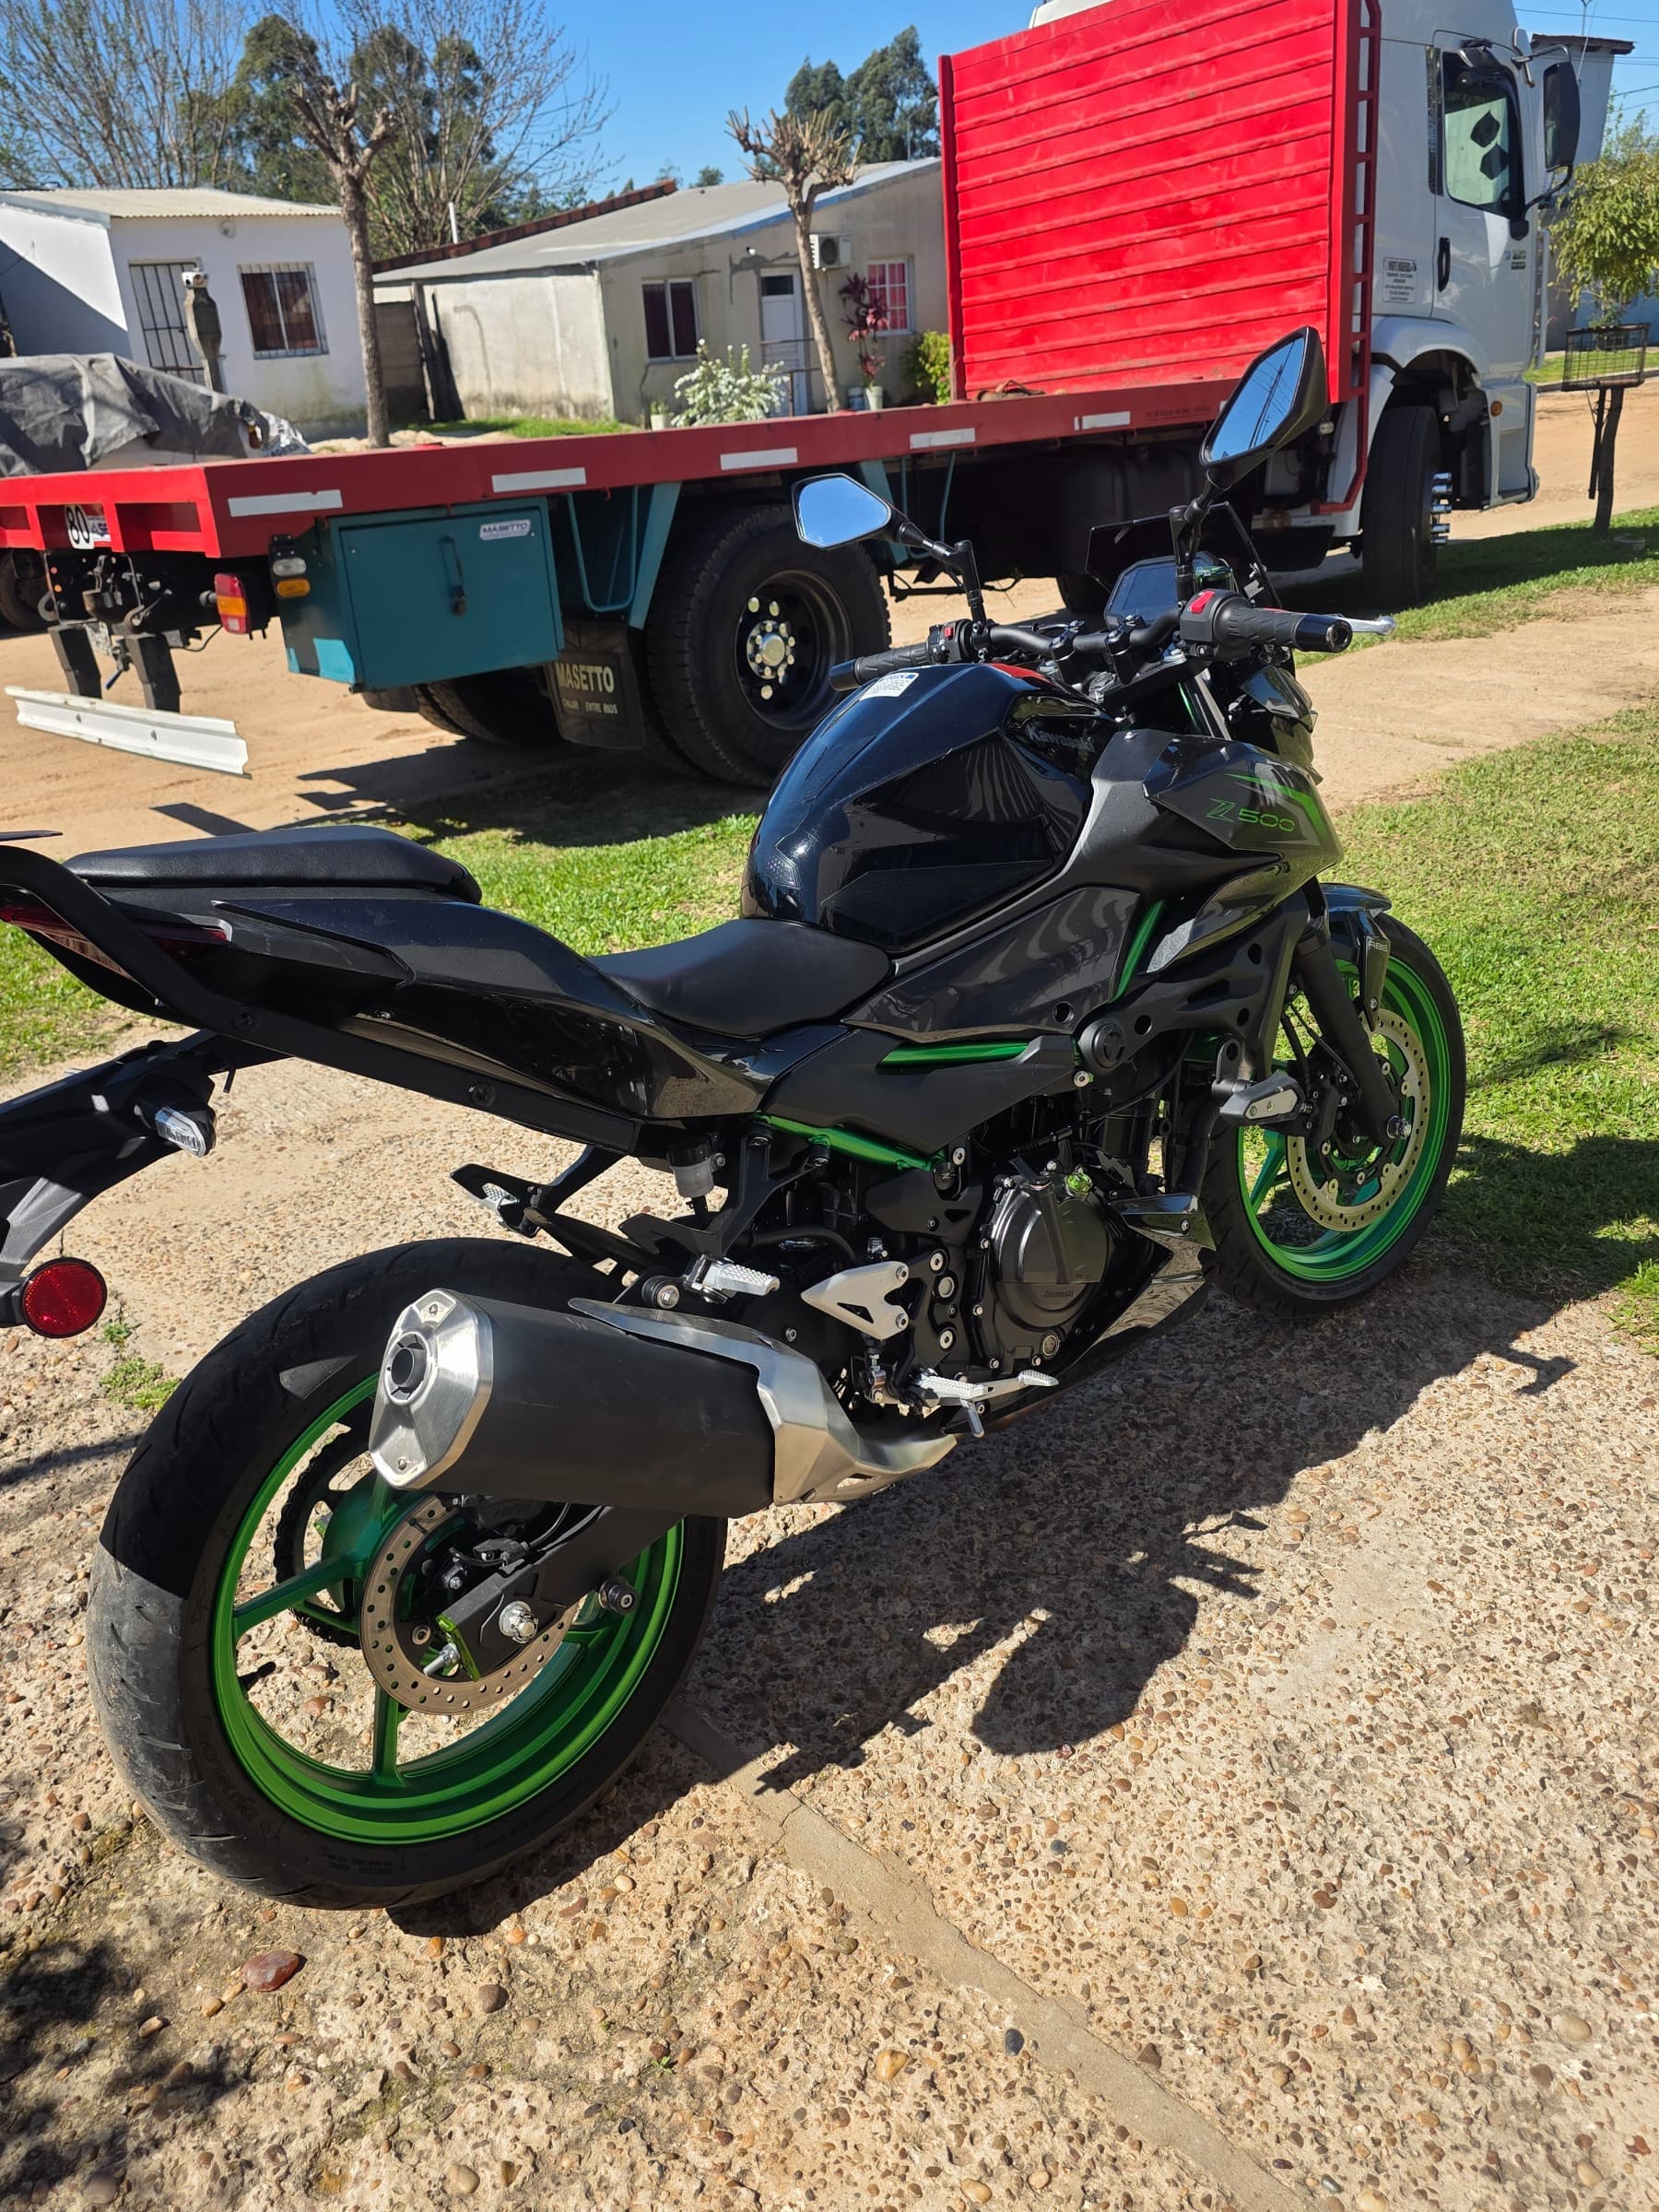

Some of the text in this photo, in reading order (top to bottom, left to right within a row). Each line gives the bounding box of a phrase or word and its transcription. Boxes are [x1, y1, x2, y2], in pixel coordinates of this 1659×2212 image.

[65, 506, 90, 545] 80
[483, 523, 528, 533] MASETTO
[554, 662, 615, 693] MASETTO
[1025, 723, 1095, 752] Kawasaki
[1368, 940, 1388, 952] ABS
